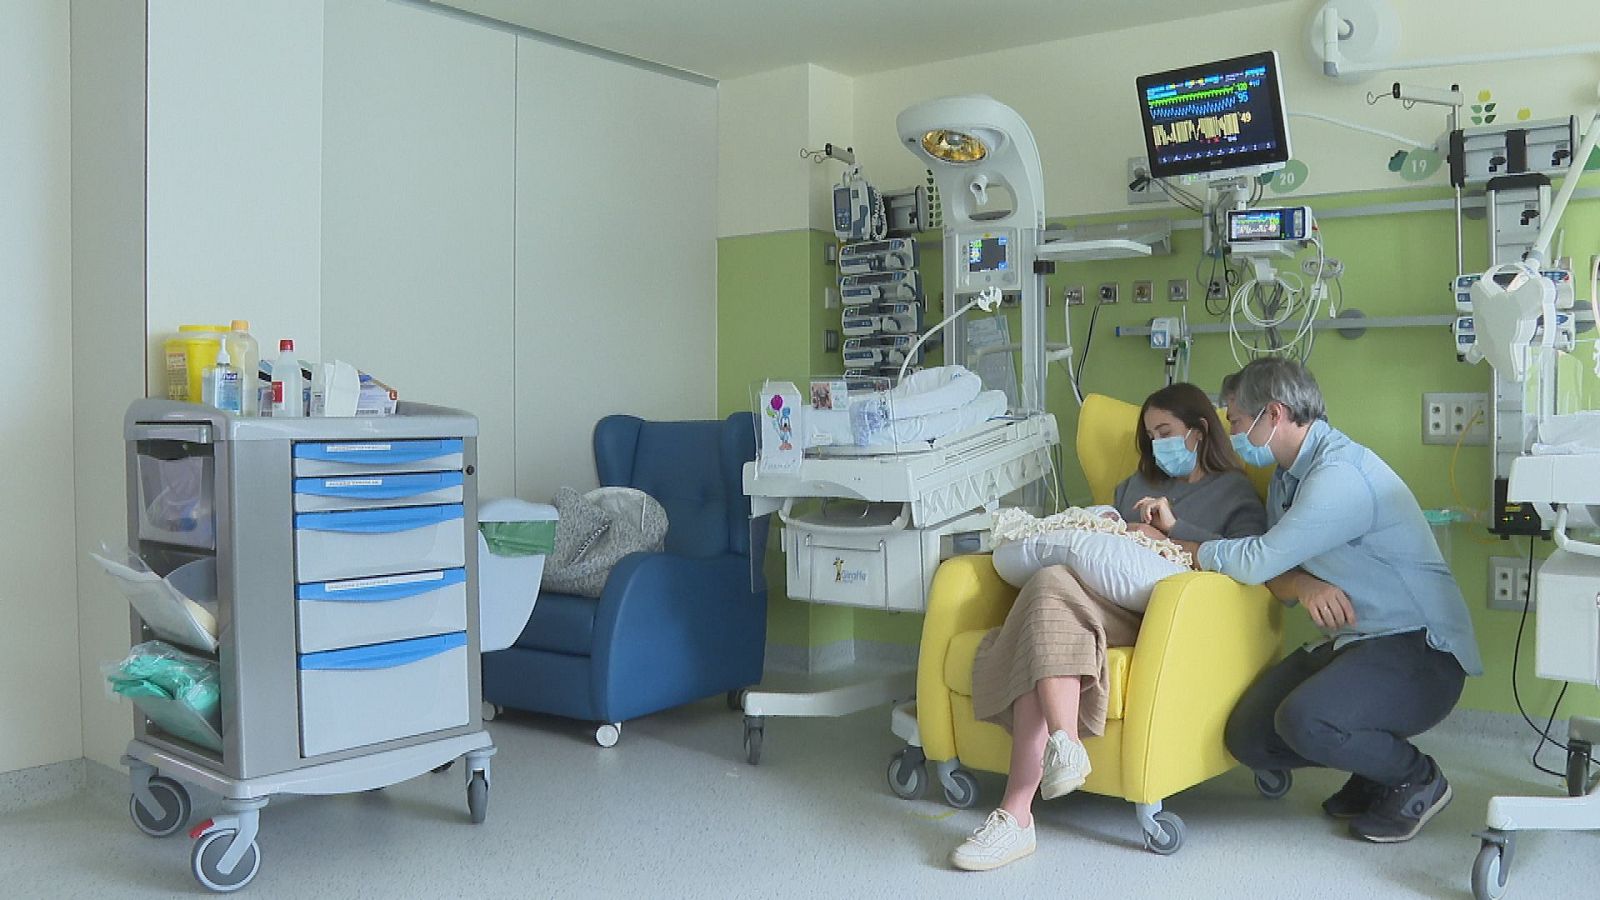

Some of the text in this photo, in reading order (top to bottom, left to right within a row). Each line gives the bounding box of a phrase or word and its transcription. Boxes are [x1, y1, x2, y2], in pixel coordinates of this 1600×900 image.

[1238, 92, 1249, 102] 95
[1240, 111, 1252, 123] 49
[1411, 159, 1427, 174] 19
[1279, 172, 1295, 186] 20
